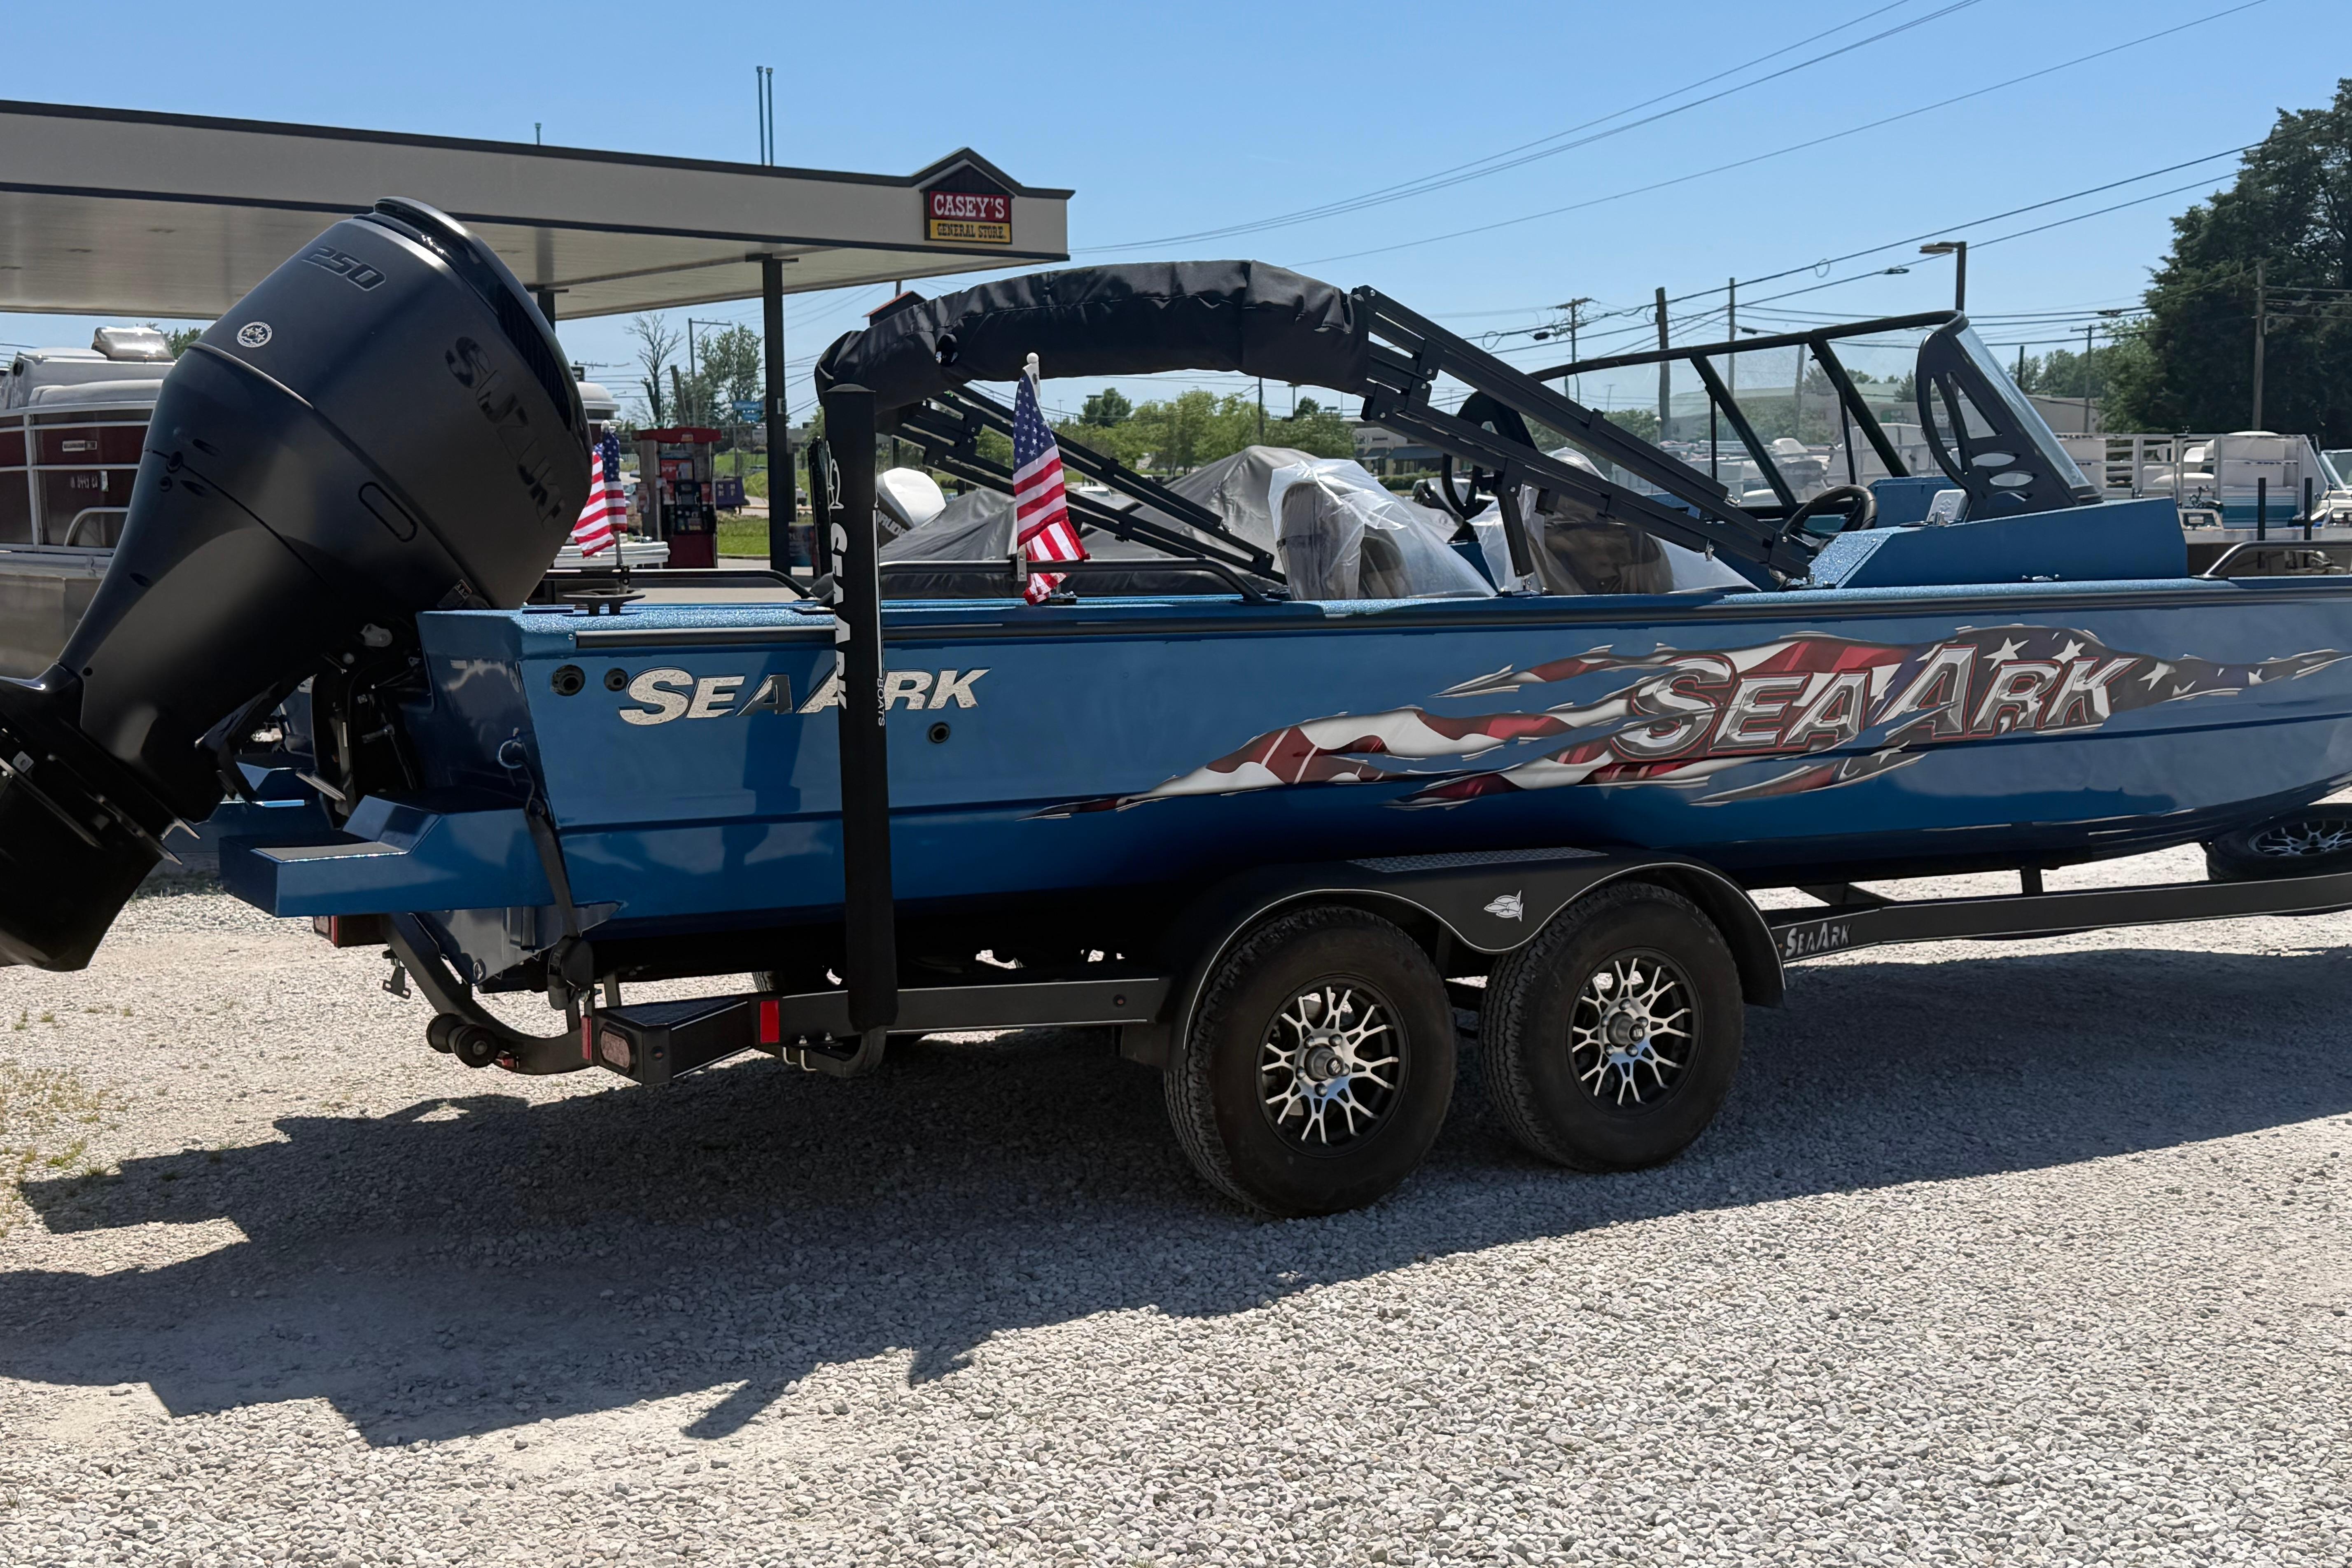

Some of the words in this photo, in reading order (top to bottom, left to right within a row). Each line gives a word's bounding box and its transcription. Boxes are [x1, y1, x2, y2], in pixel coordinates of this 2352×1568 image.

[934, 195, 1005, 218] CASEY'S
[938, 223, 975, 237] GENERAL
[301, 246, 386, 291] 250
[877, 678, 885, 726] BOATS
